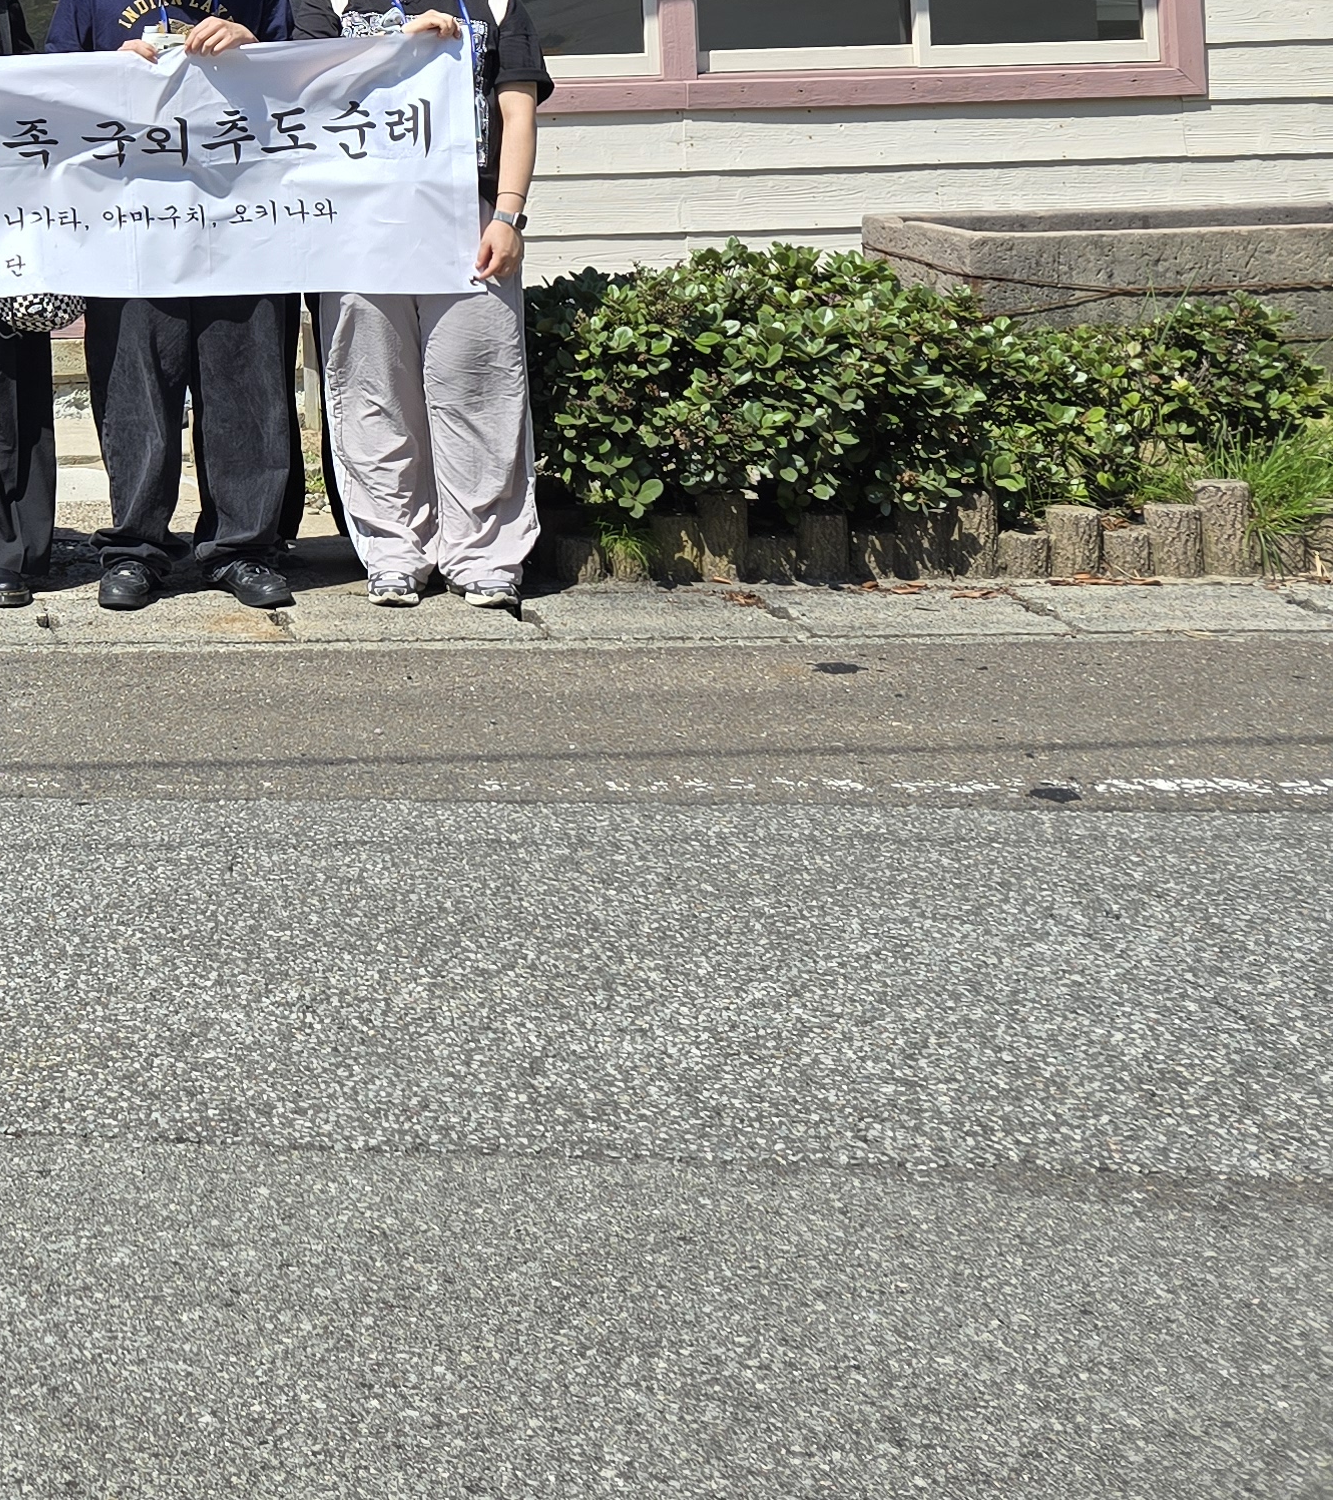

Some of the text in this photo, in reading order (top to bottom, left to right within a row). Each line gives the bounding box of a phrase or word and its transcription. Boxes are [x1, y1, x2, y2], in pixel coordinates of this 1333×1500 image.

[81, 98, 433, 167] 국외추도순례
[4, 204, 91, 233] 니가타,
[102, 203, 218, 232] 야마구치,
[228, 197, 339, 228] 오키나와
